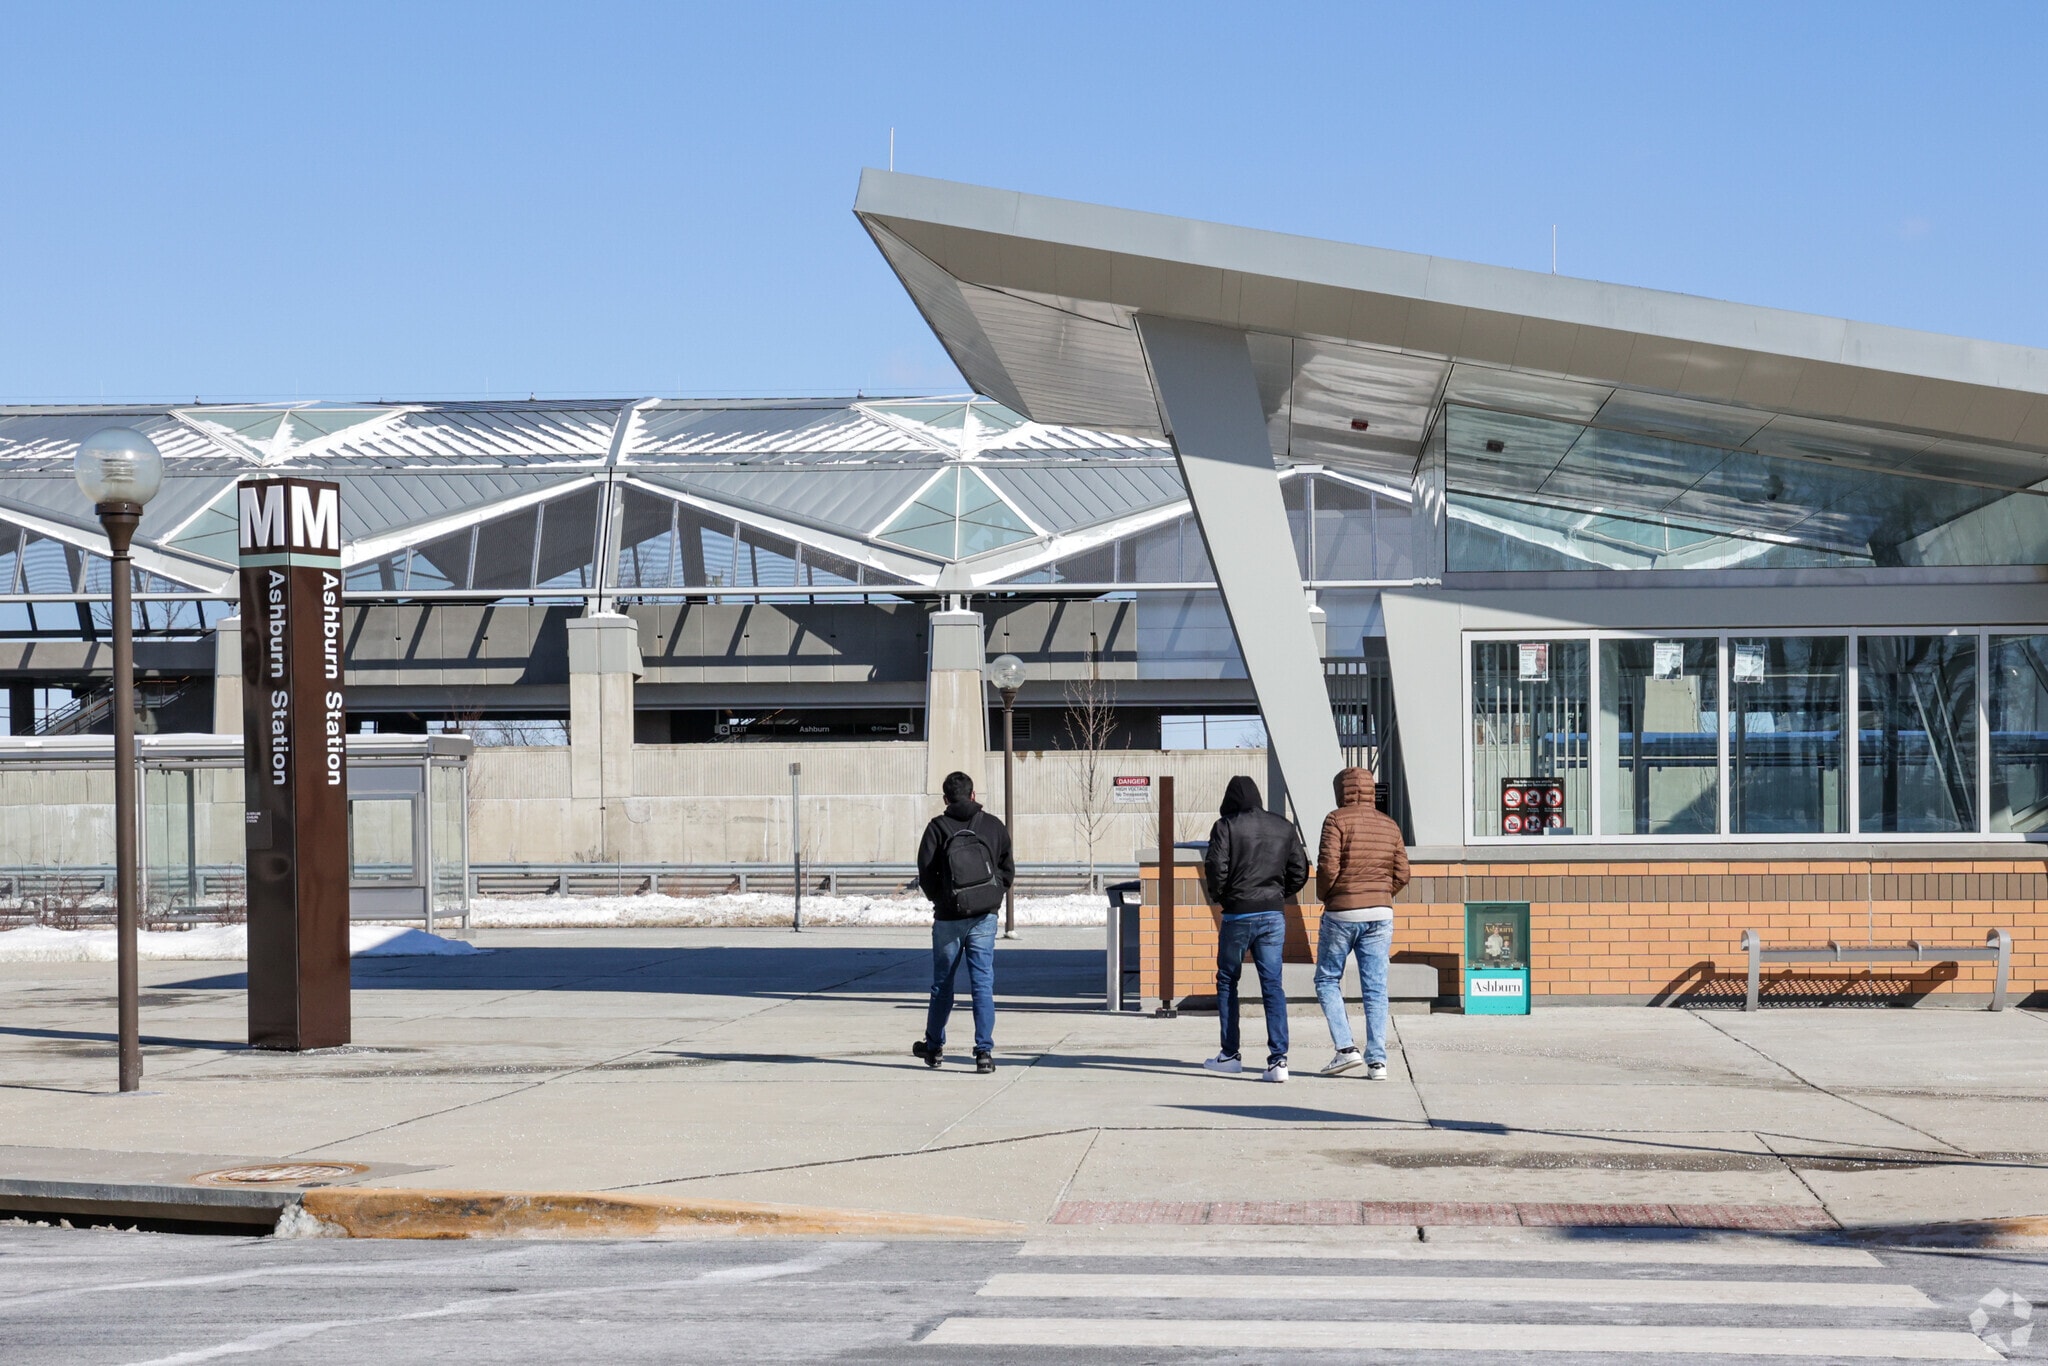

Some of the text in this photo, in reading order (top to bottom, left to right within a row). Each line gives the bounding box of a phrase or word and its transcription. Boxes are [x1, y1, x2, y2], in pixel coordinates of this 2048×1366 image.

[239, 485, 285, 549] M
[290, 485, 339, 550] M
[268, 569, 289, 785] Ashburn Station
[322, 571, 344, 785] Ashburn Station
[1473, 980, 1521, 992] Ashburn
